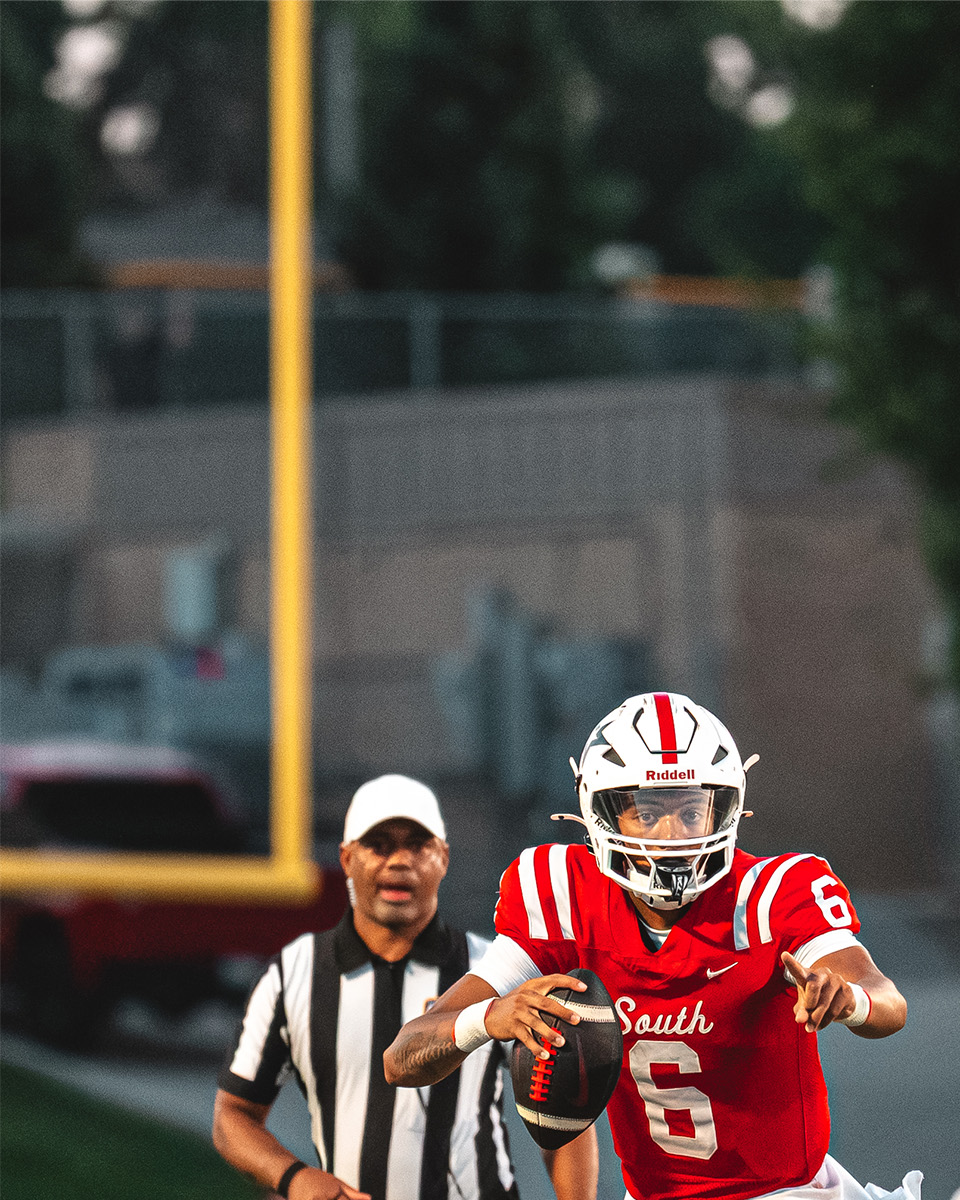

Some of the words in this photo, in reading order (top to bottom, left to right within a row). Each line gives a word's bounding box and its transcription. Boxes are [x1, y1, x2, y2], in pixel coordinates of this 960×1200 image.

[645, 769, 696, 781] Riddell
[810, 873, 853, 929] 6
[614, 996, 715, 1036] South
[628, 1039, 719, 1161] 6
